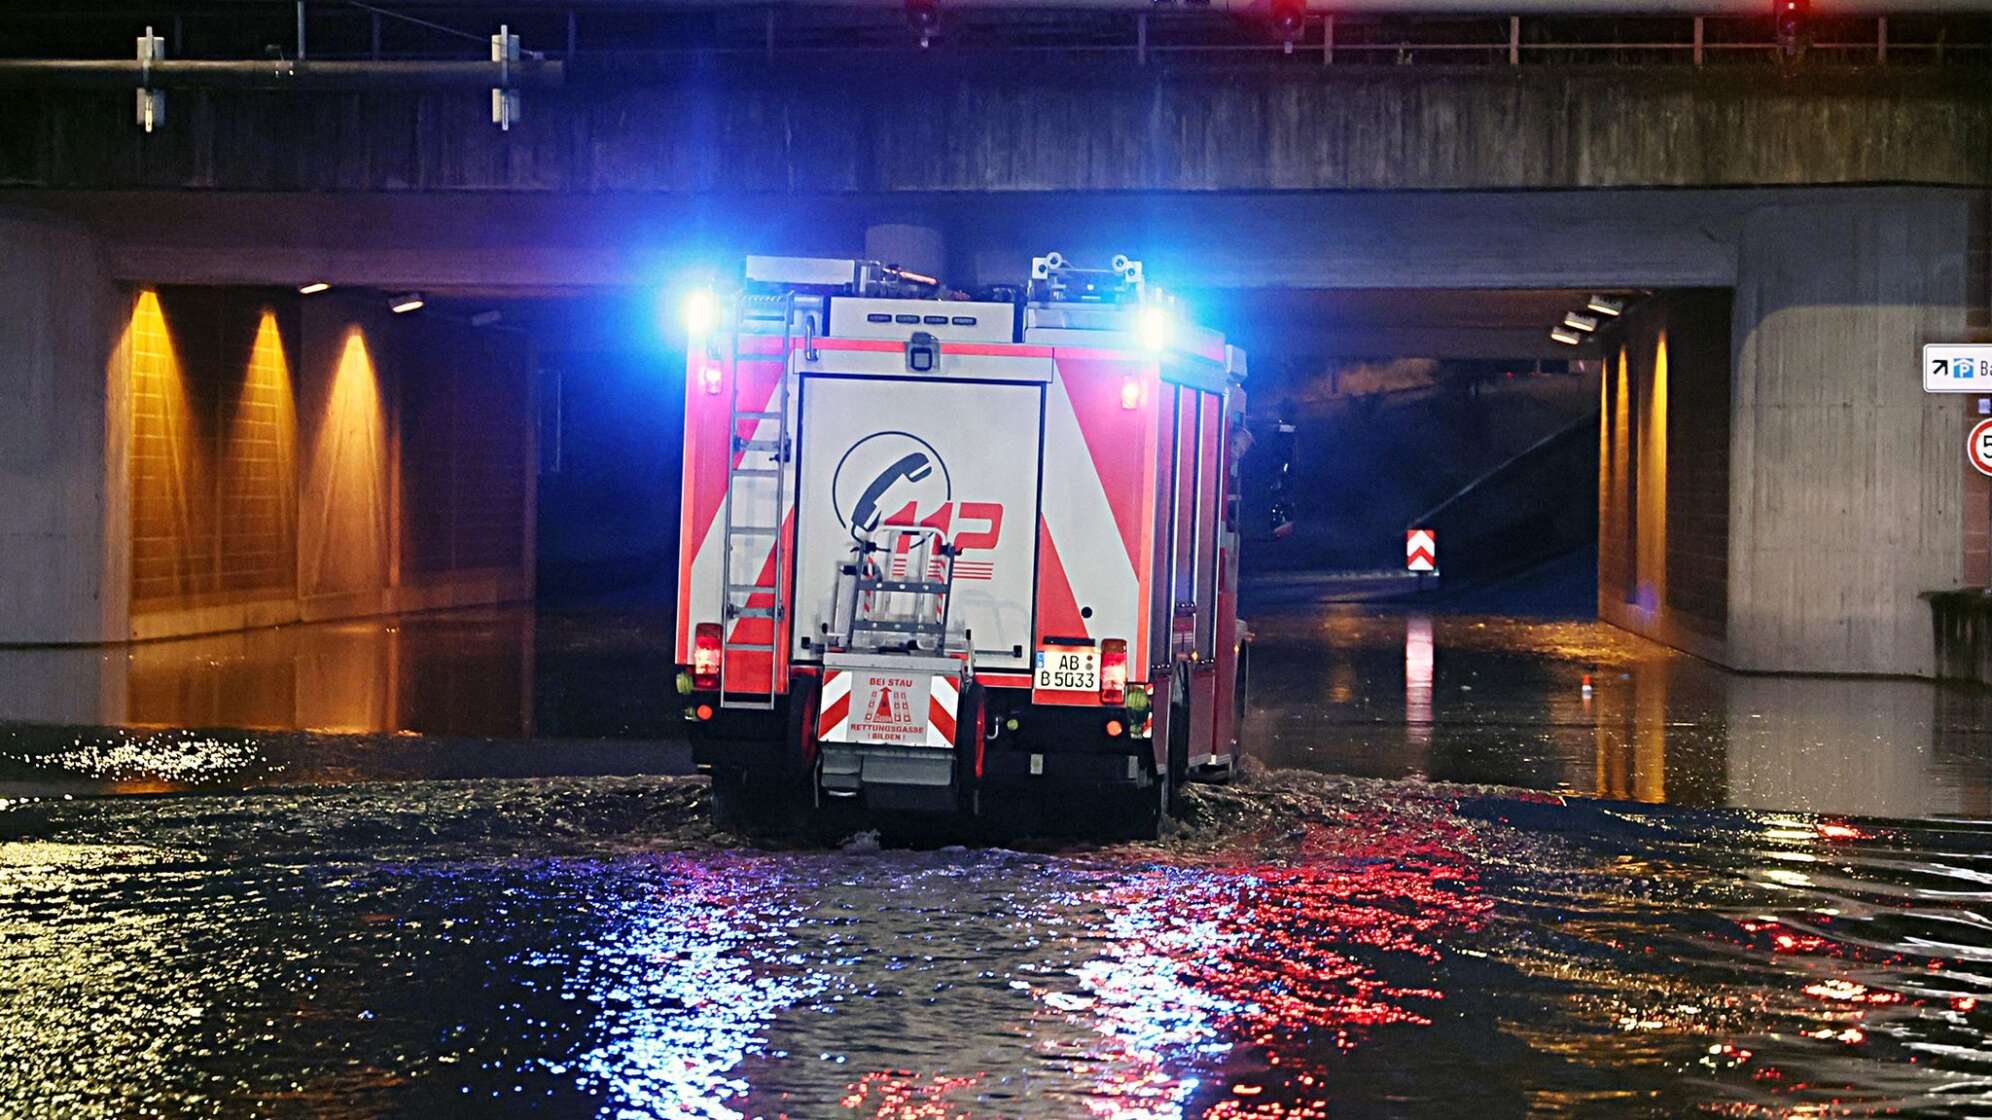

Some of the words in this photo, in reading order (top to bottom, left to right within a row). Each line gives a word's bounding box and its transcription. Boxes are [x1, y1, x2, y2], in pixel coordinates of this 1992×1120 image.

[884, 500, 1004, 579] 112
[1059, 655, 1080, 671] AB
[869, 677, 886, 686] BEI
[888, 678, 913, 688] STAU
[1040, 671, 1051, 687] B
[1054, 672, 1095, 689] 5033
[851, 724, 925, 734] RETTUNGSGASSE
